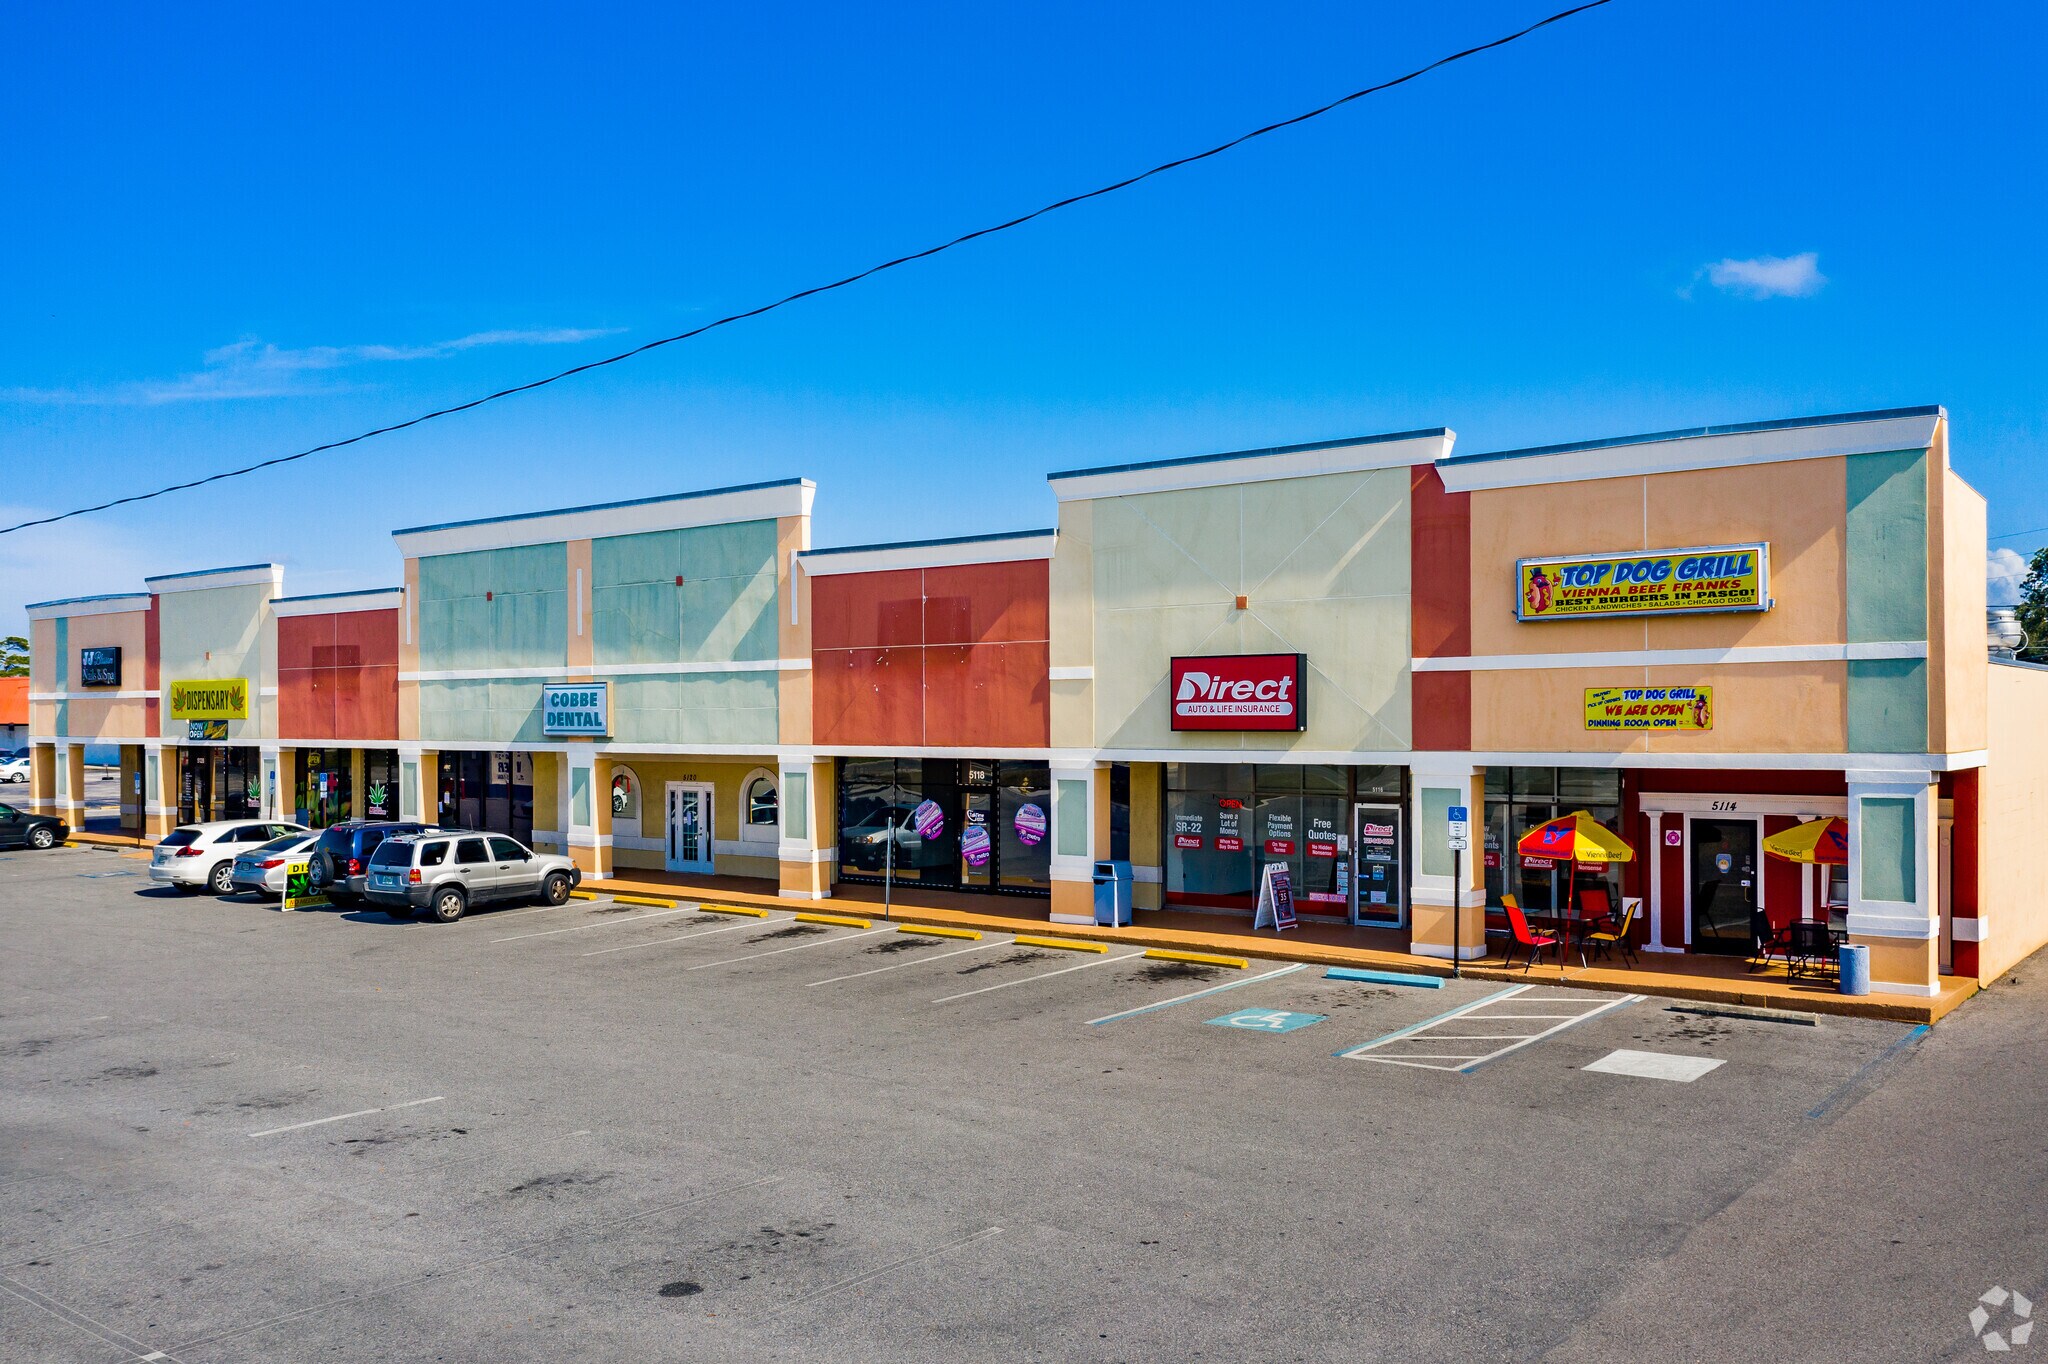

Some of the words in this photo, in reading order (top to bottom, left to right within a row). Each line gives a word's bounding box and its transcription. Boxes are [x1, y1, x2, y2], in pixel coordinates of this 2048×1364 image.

[1560, 564, 1612, 588] TOP
[1612, 560, 1672, 586] DOG
[1674, 554, 1753, 582] GRILL
[1561, 586, 1621, 599] VIENNA
[1627, 584, 1667, 594] BEEF
[1672, 580, 1742, 592] FRANKS
[1555, 597, 1594, 607] BEST
[1598, 593, 1669, 604] BURGERS
[1674, 592, 1691, 600] IN
[1697, 589, 1756, 599] PASCO!
[1555, 605, 1589, 613] CHICKEN
[1591, 602, 1643, 611] SANDWICHES
[1648, 600, 1681, 608] SALADS
[1687, 598, 1726, 606] CHICAGO
[1176, 671, 1293, 701] Direct
[551, 692, 598, 708] COBBE
[1623, 689, 1644, 702] TOP
[1644, 689, 1667, 701] DOG
[1667, 688, 1697, 701] GRILL
[187, 690, 229, 711] DISPENSARY
[1188, 705, 1208, 713] AUTO
[1210, 705, 1215, 713] &
[1217, 705, 1233, 713] LIFE
[1235, 705, 1281, 713] INSURANCE
[1605, 704, 1623, 717] WE
[1623, 704, 1648, 717] ARE
[1650, 704, 1685, 717] OPEN
[547, 711, 603, 727] DENTAL
[1587, 719, 1621, 728] DINNING
[1623, 719, 1650, 728] ROOM
[1653, 719, 1676, 728] OPEN
[190, 722, 204, 730] NOW
[968, 771, 985, 780] 5118
[1219, 798, 1243, 809] OPEN
[1711, 801, 1737, 811] 5114
[1175, 813, 1203, 822] Immediate
[1220, 811, 1234, 820] Save
[1268, 813, 1292, 823] Flexible
[1176, 821, 1202, 833] SR-22
[1221, 819, 1230, 828] Lot
[1230, 819, 1238, 828] of
[1267, 821, 1293, 831] Payment
[1313, 817, 1332, 829] Free
[1365, 823, 1394, 833] Direct
[1219, 827, 1239, 837] Money
[1268, 829, 1292, 838] Options
[1308, 829, 1337, 841] Quotes
[1026, 833, 1041, 842] metro
[976, 851, 990, 862] metro
[1311, 849, 1333, 857] Nonsense
[1524, 856, 1553, 865] Direct
